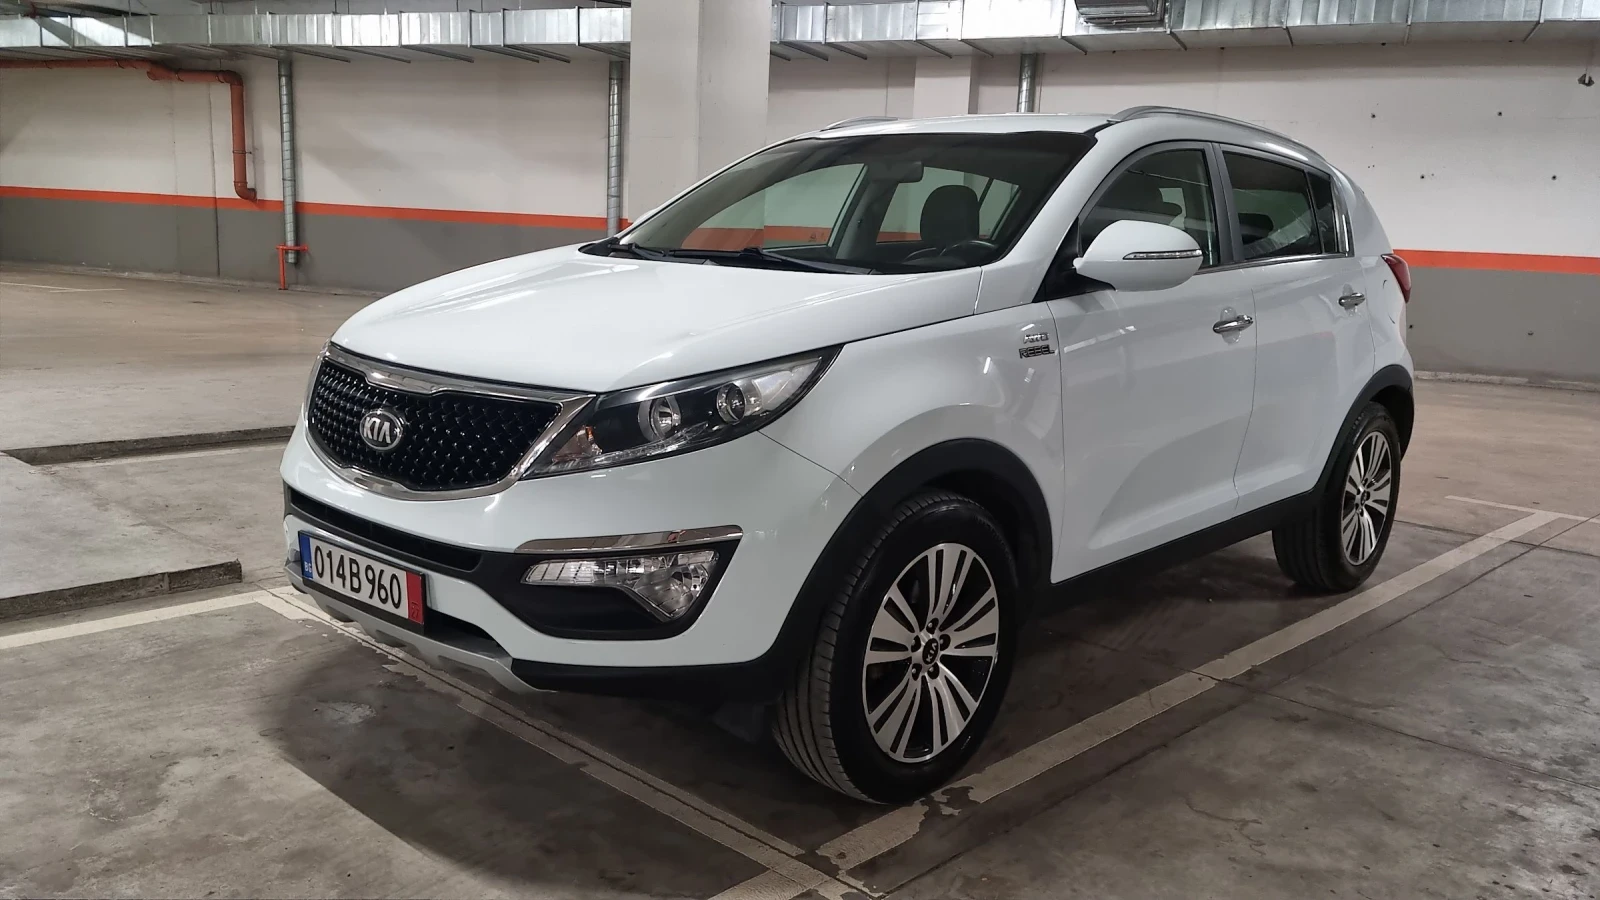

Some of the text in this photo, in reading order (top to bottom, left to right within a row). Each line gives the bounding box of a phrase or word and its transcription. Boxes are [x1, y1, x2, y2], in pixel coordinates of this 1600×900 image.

[1019, 344, 1055, 359] REBEL
[363, 416, 391, 444] KIA
[314, 545, 402, 609] 014B960
[926, 642, 937, 662] KIA
